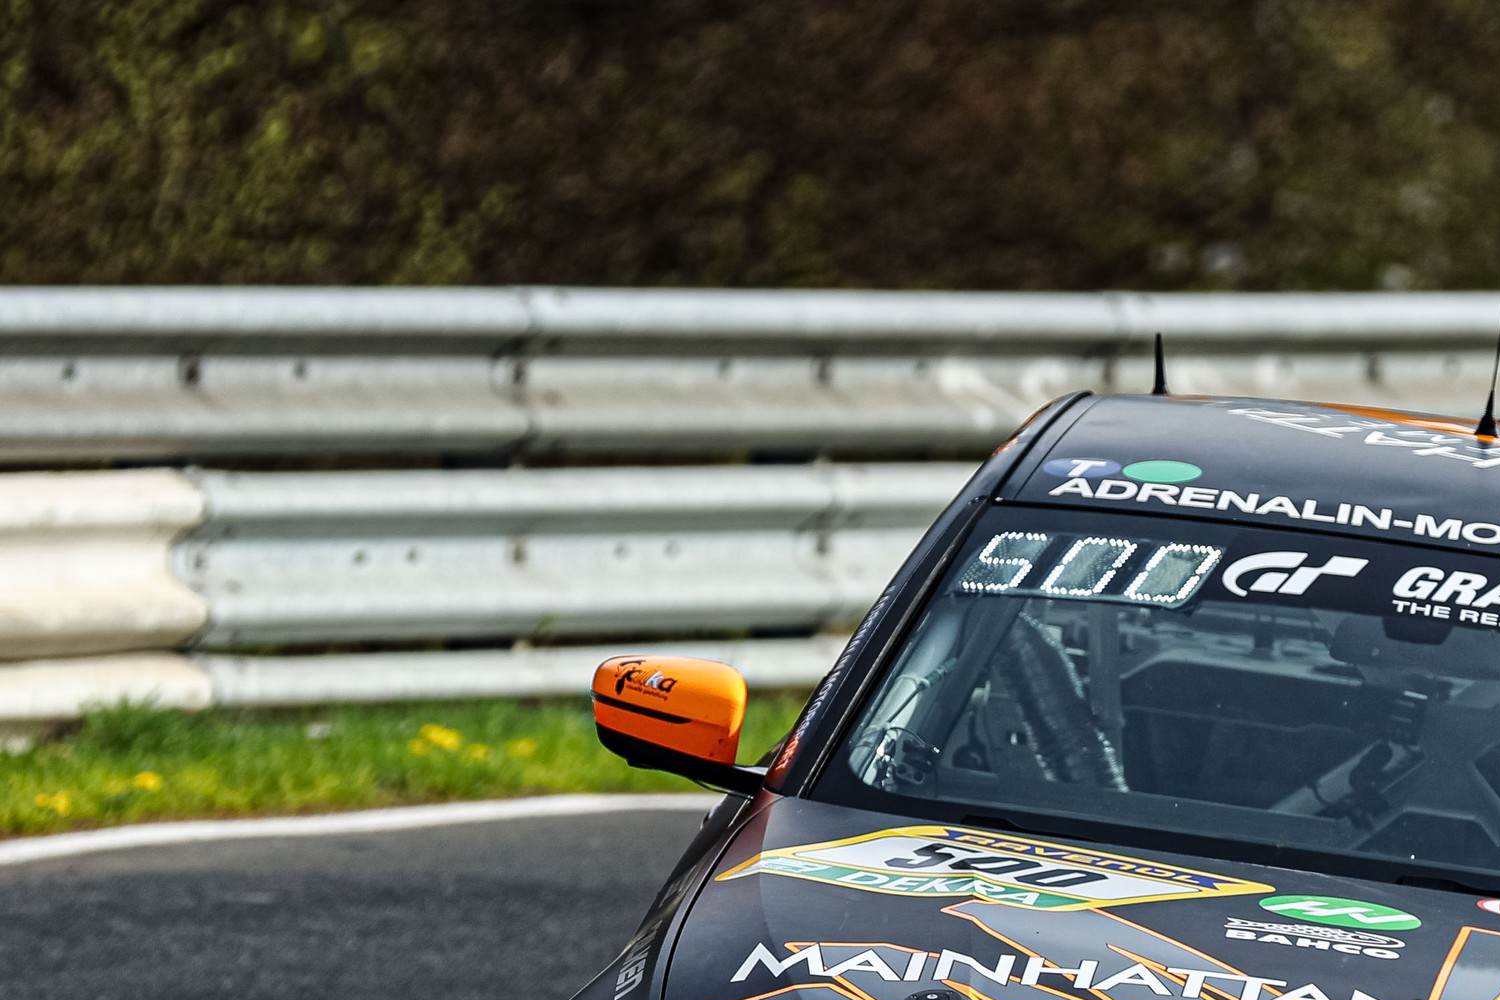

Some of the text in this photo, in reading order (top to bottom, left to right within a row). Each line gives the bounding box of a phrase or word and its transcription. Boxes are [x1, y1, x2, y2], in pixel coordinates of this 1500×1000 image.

[960, 531, 1223, 603] 500
[1392, 599, 1450, 619] THE
[884, 843, 1109, 888] 500
[836, 871, 1040, 905] DEKRA
[1225, 929, 1400, 959] BAHCO
